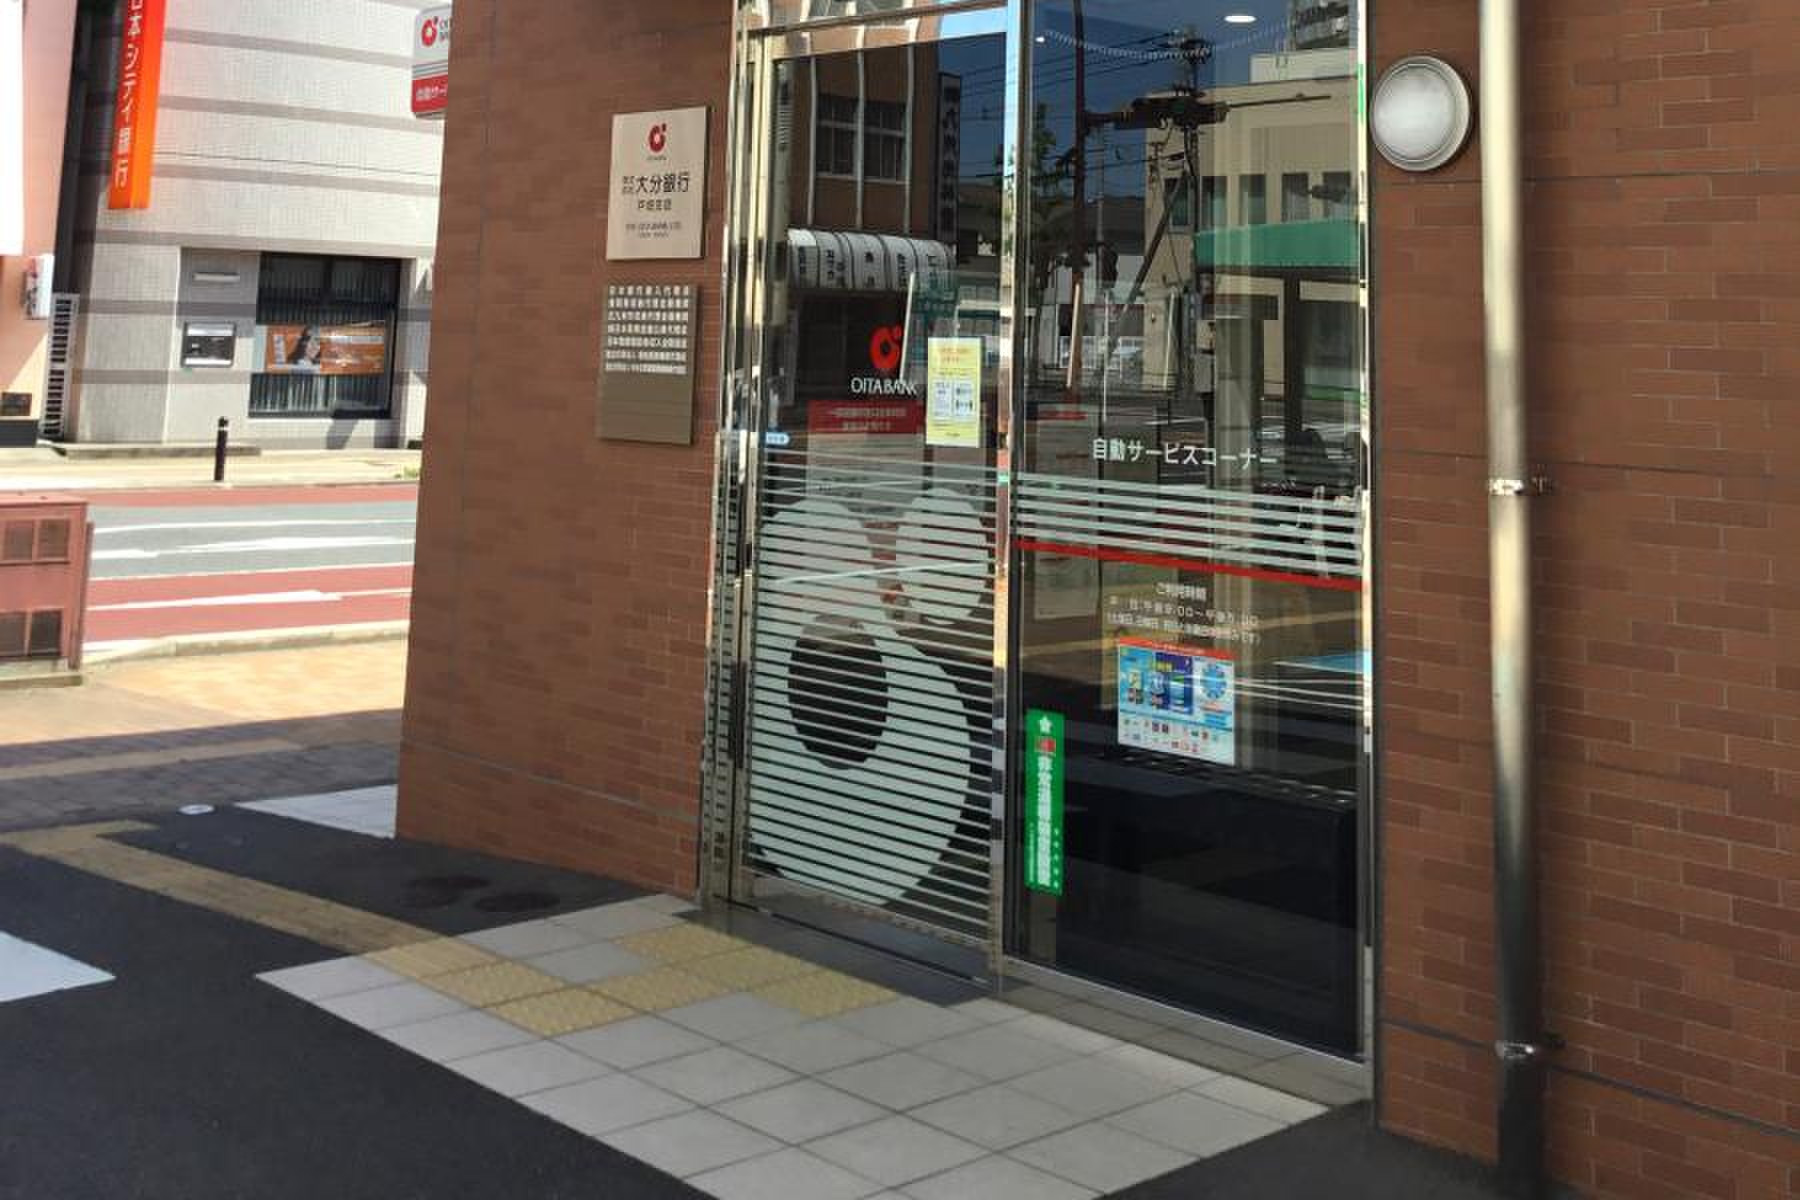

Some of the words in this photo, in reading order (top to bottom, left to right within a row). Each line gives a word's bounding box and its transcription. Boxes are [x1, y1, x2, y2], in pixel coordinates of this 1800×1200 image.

[850, 377, 884, 395] OITA
[884, 378, 917, 396] BANK
[1092, 437, 1278, 470] 自動サービスコーナー
